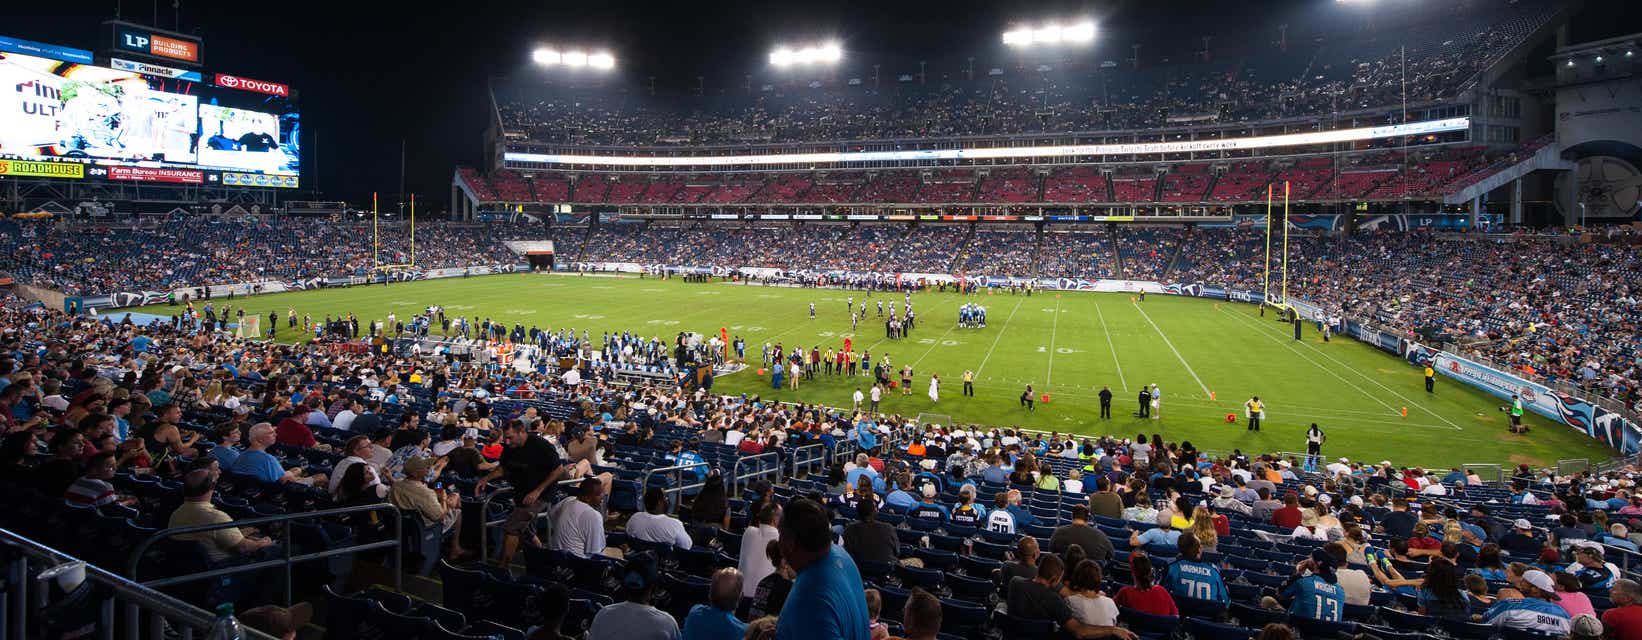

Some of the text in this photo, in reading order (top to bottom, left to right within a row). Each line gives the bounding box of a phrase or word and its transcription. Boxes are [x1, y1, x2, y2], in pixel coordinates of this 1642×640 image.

[125, 34, 149, 48] LP
[138, 63, 174, 76] Pinnacle
[239, 79, 285, 94] TOYOTA
[14, 162, 80, 175] ROADHOUSE
[111, 167, 201, 178] Farm Bureau INSURANCE
[1420, 218, 1432, 226] LP
[1181, 578, 1211, 600] 70
[1315, 594, 1338, 622] 13
[1537, 614, 1560, 627] BROWN
